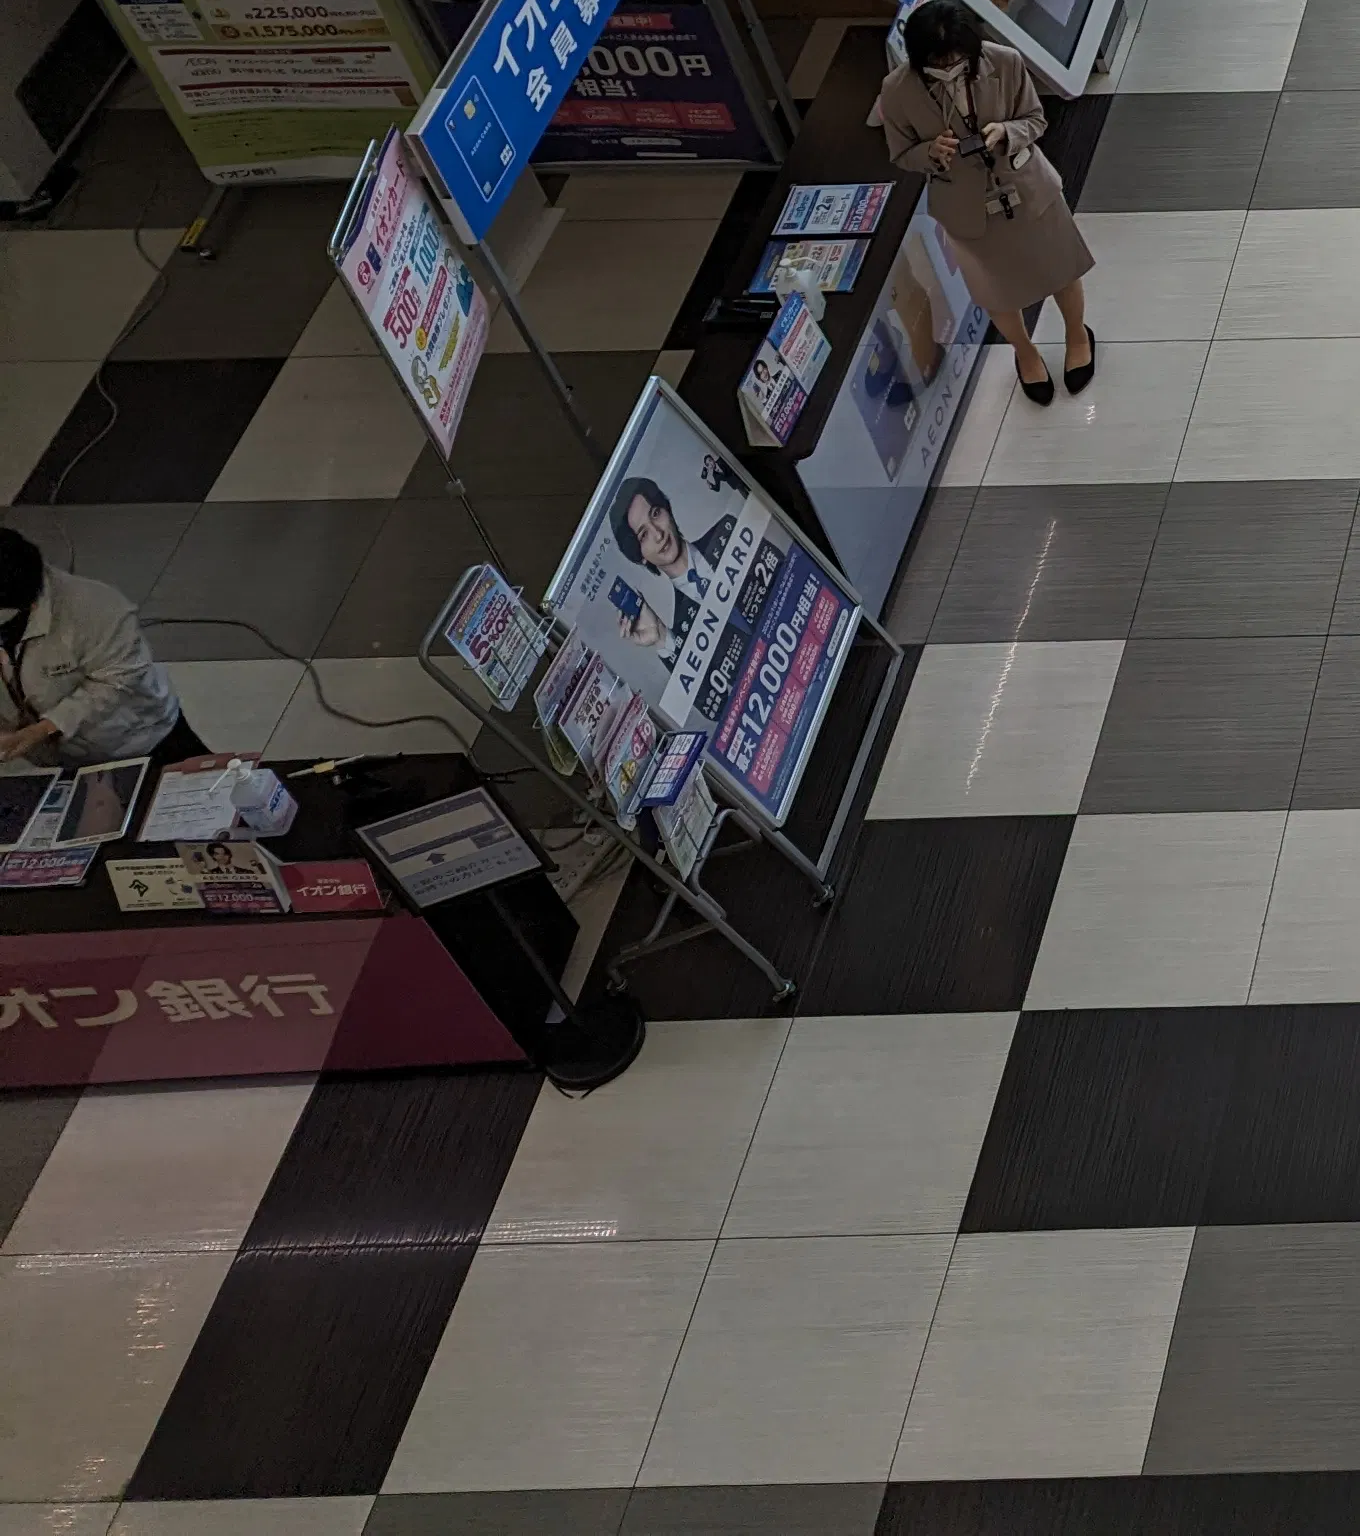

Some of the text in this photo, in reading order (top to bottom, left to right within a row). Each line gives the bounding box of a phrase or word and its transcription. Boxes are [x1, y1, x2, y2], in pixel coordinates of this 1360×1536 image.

[375, 156, 406, 248] イオンカード
[921, 306, 983, 468] AEON CARD
[679, 609, 721, 693] AEON
[716, 526, 754, 603] CARD
[746, 584, 767, 625] いつでも
[296, 883, 366, 897] イオン銀行
[0, 973, 336, 1029] オン銀行
